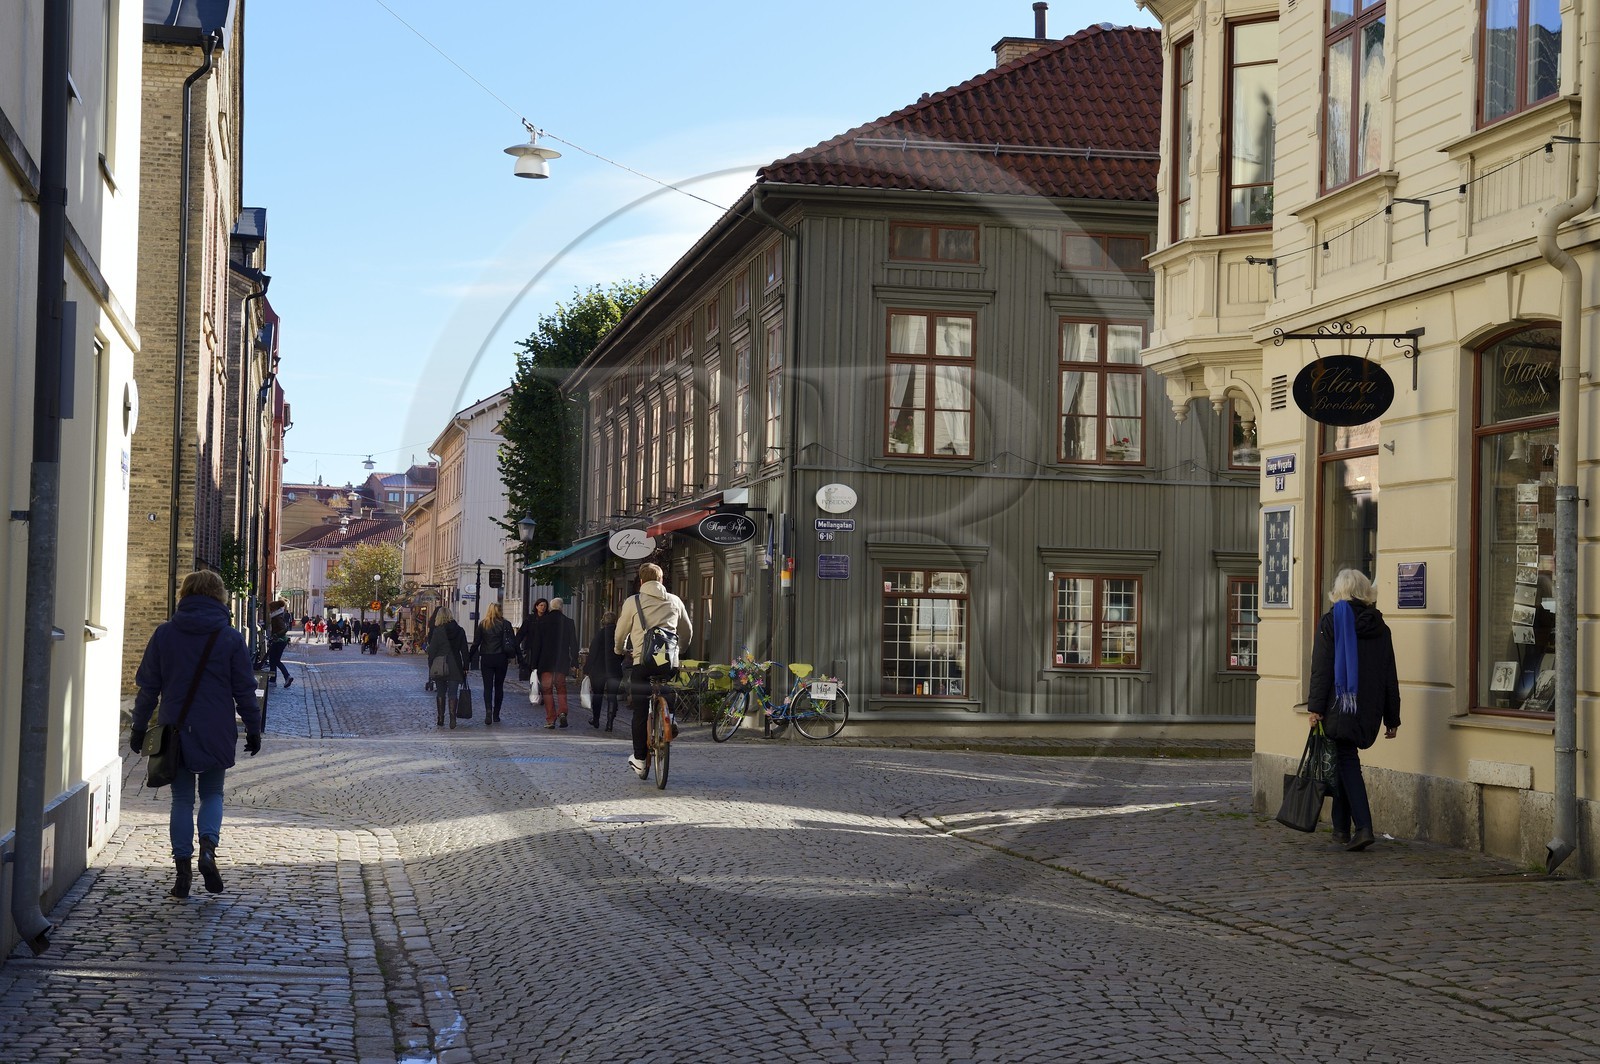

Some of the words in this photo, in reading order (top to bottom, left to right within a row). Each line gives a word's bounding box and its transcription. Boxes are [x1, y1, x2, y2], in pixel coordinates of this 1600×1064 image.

[1503, 347, 1553, 386] Clara
[1310, 366, 1378, 394] Clara
[1310, 396, 1376, 414] Bookshop
[1502, 384, 1550, 408] Bookshop
[817, 520, 853, 530] Mellangatan
[819, 532, 833, 541] 6-16
